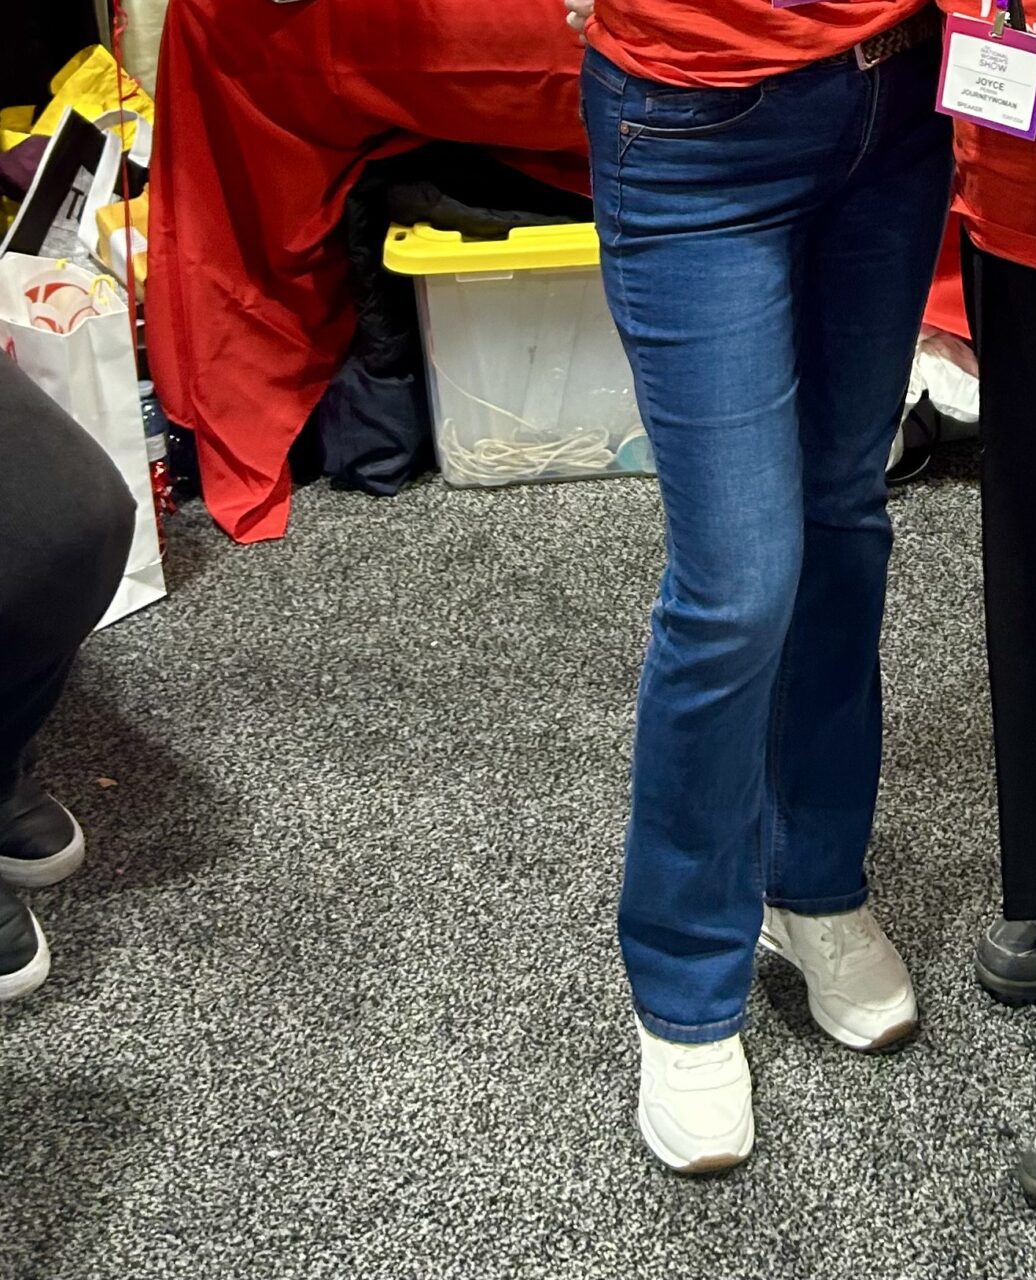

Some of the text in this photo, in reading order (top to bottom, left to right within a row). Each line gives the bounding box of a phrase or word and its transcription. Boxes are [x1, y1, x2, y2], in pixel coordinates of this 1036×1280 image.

[979, 59, 1008, 72] SHOW
[975, 76, 1006, 91] JOYCE
[961, 88, 1018, 109] JOURNEYWOMAN
